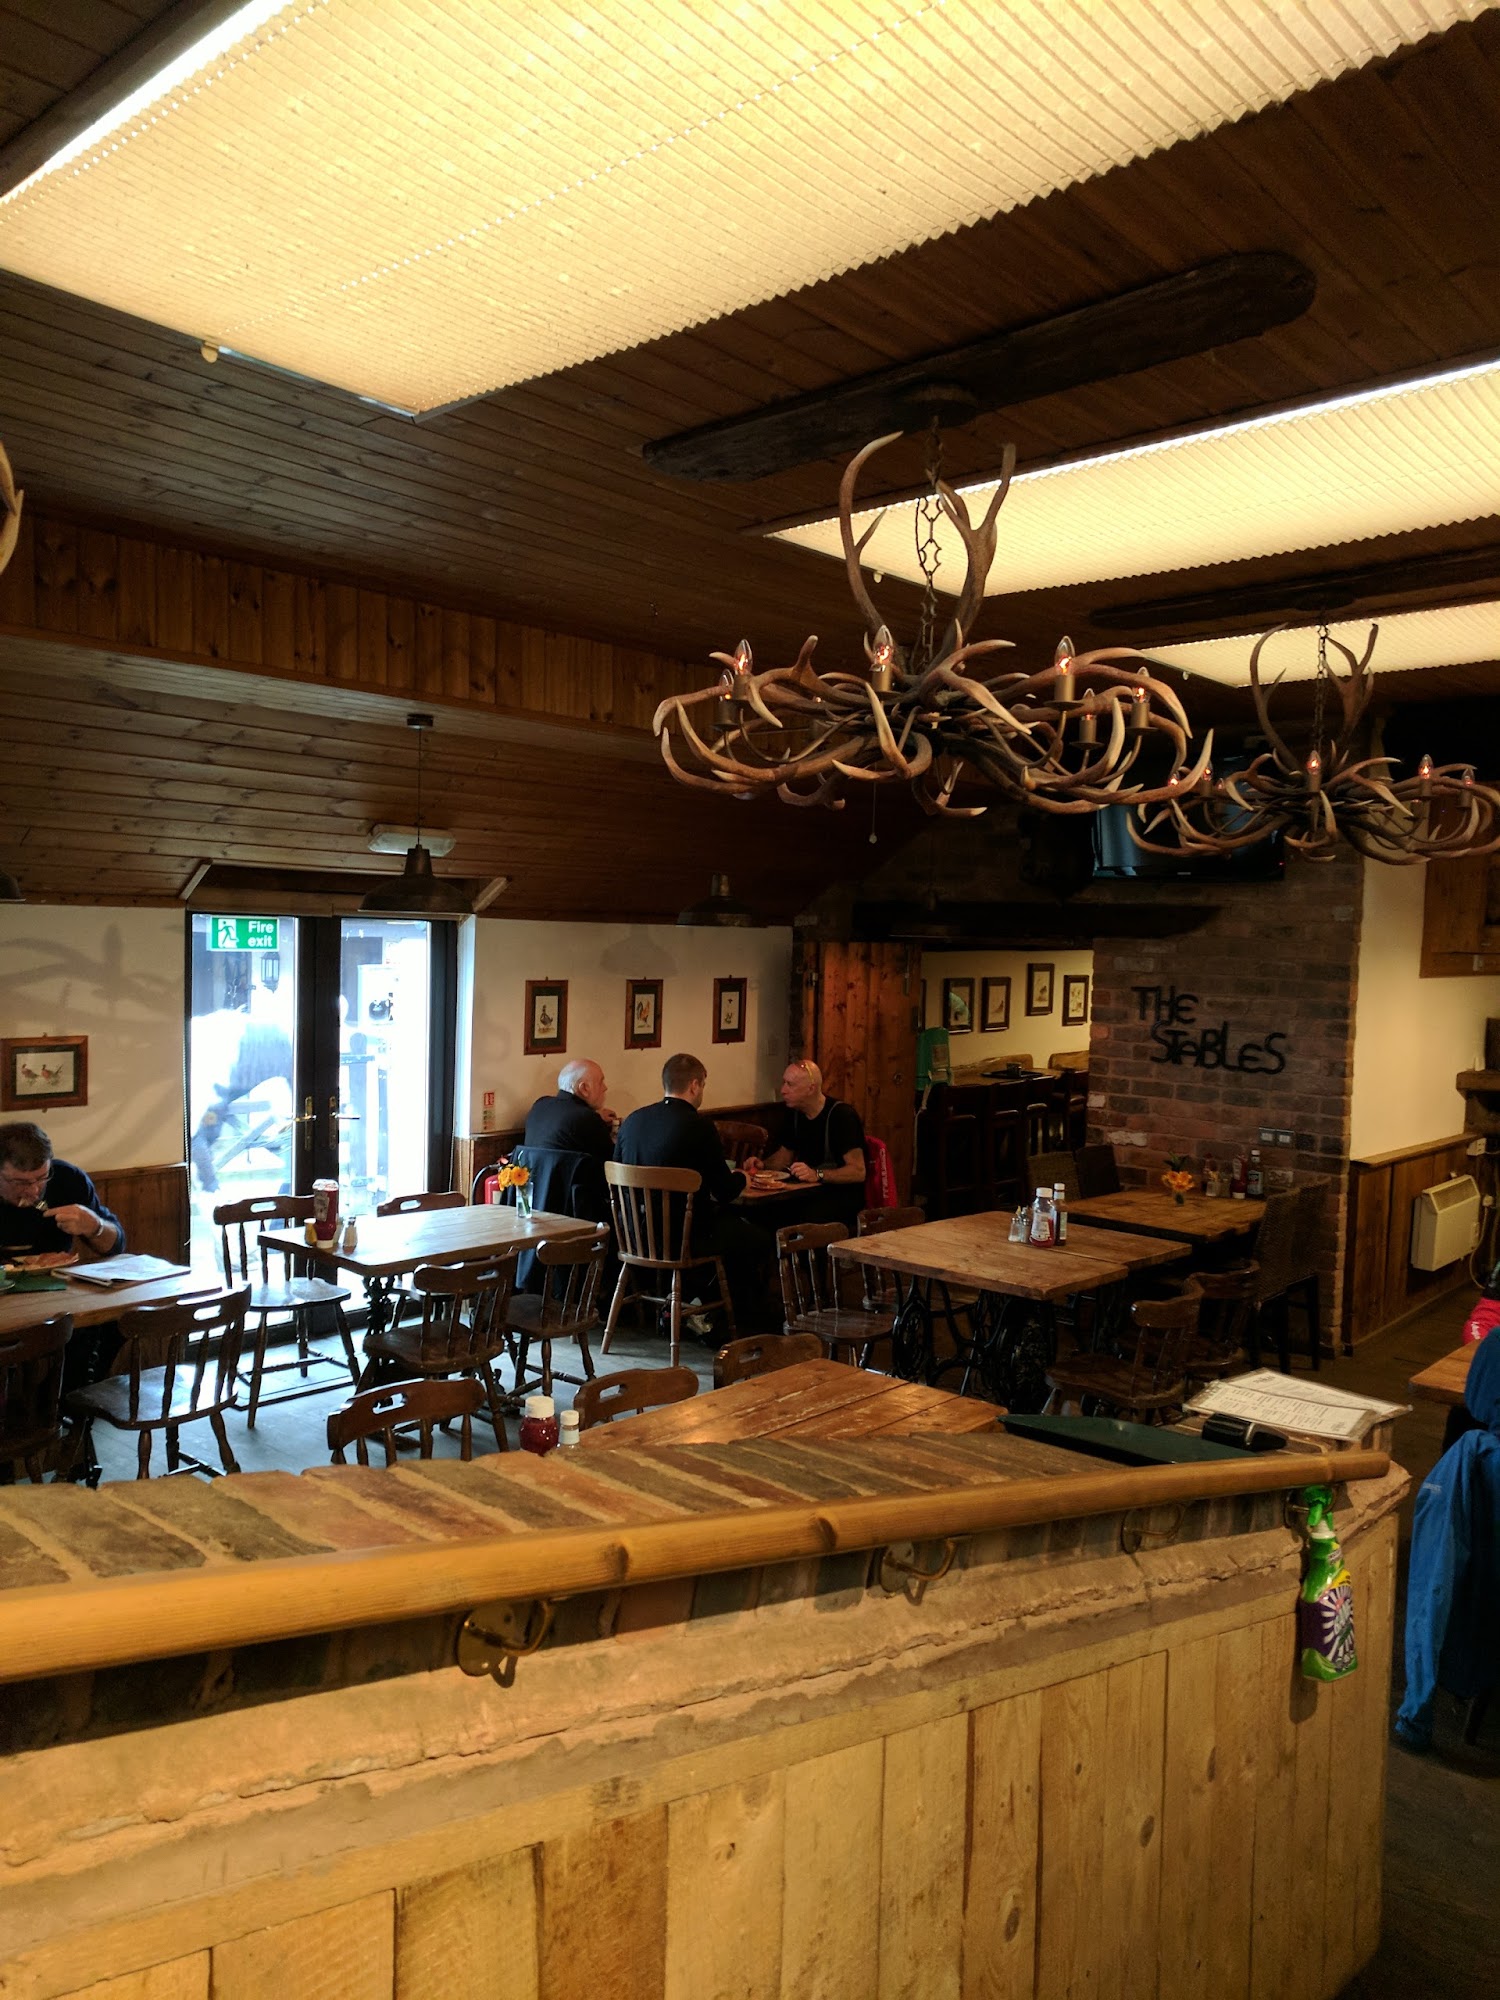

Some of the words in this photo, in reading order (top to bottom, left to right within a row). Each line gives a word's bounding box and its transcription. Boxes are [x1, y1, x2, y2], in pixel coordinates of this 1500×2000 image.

[248, 920, 274, 933] Fire
[247, 935, 273, 947] exit
[1131, 985, 1199, 1024] THE
[1150, 1019, 1286, 1075] STABLES
